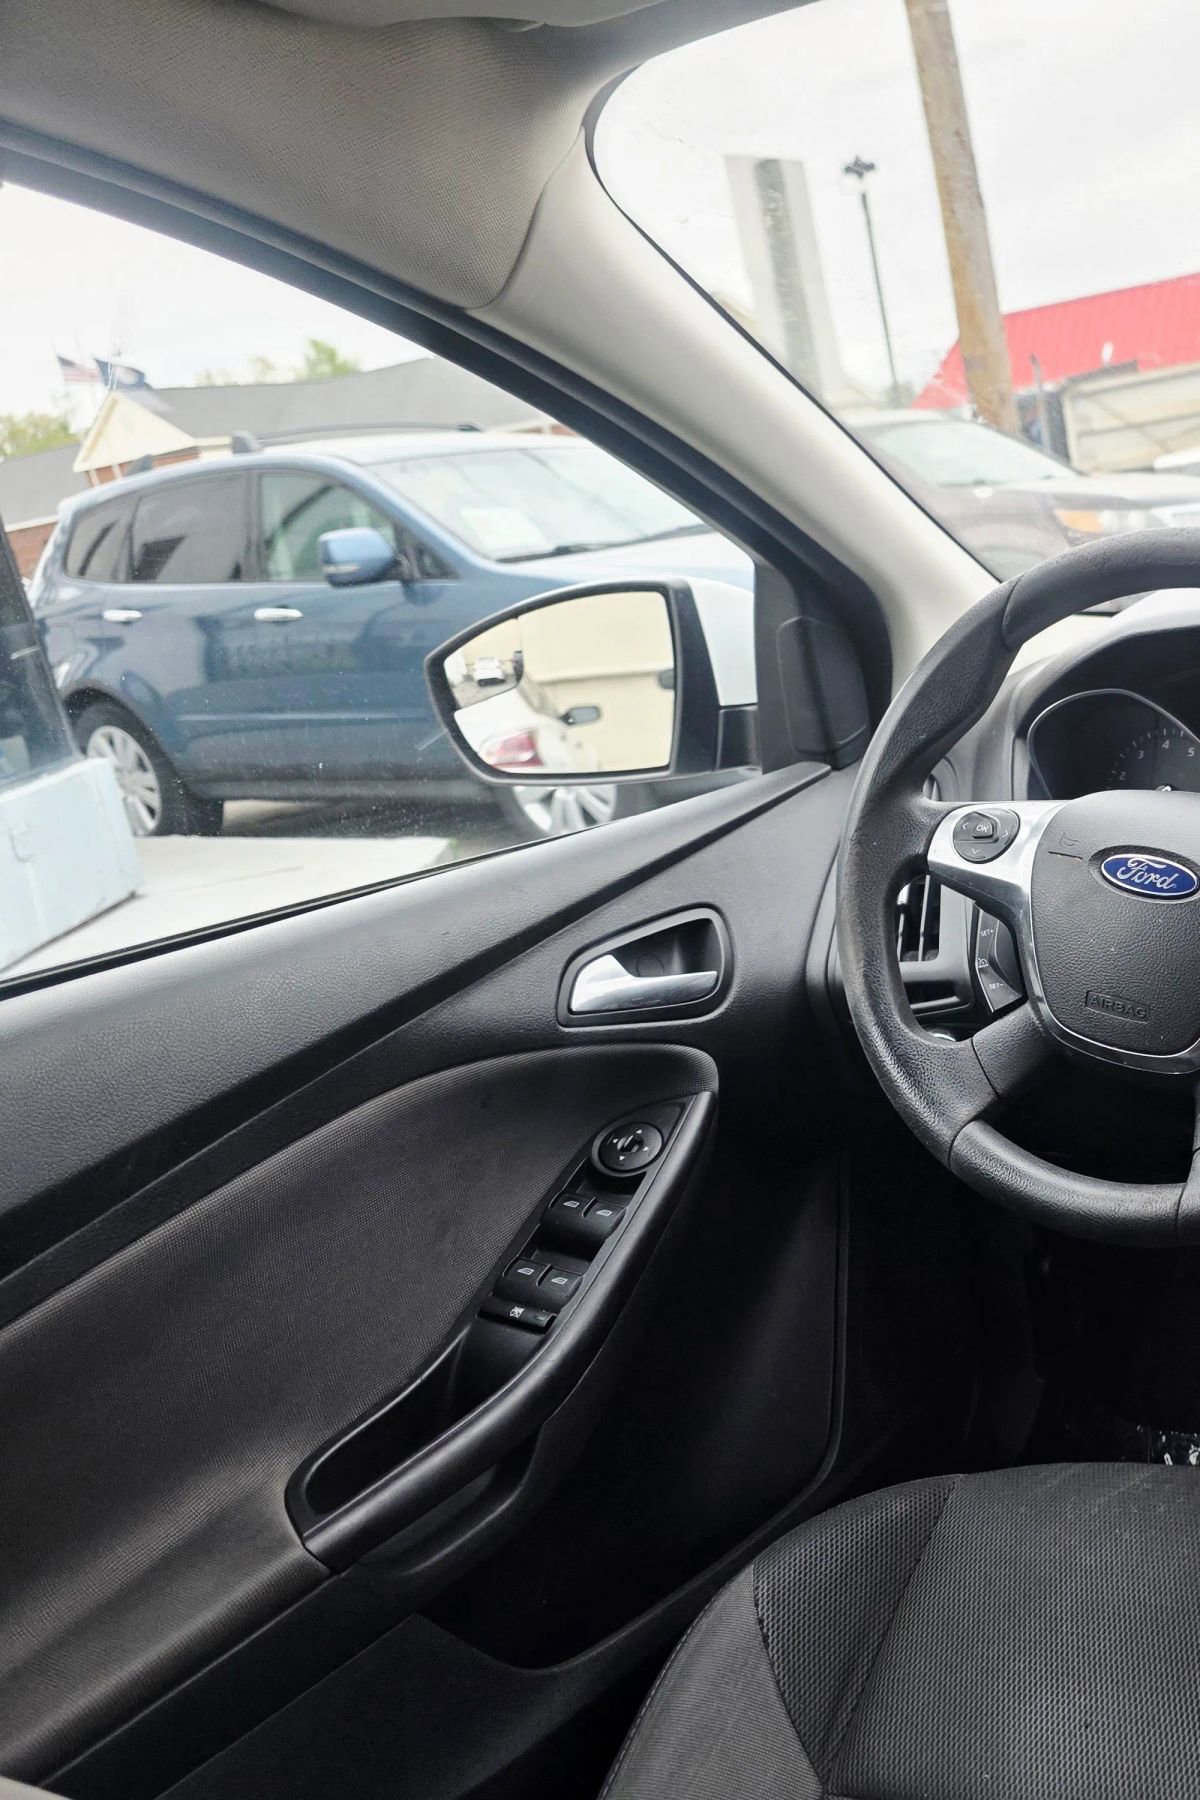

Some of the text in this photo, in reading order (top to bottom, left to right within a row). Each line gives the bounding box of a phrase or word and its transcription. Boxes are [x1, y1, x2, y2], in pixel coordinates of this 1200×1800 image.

[1162, 740, 1170, 750] 4
[1138, 750, 1145, 759] 3
[1187, 747, 1196, 757] 5
[1119, 771, 1127, 780] 2
[975, 823, 990, 833] OK
[1116, 857, 1175, 890] Ford
[1090, 995, 1148, 1019] AIRBAG
